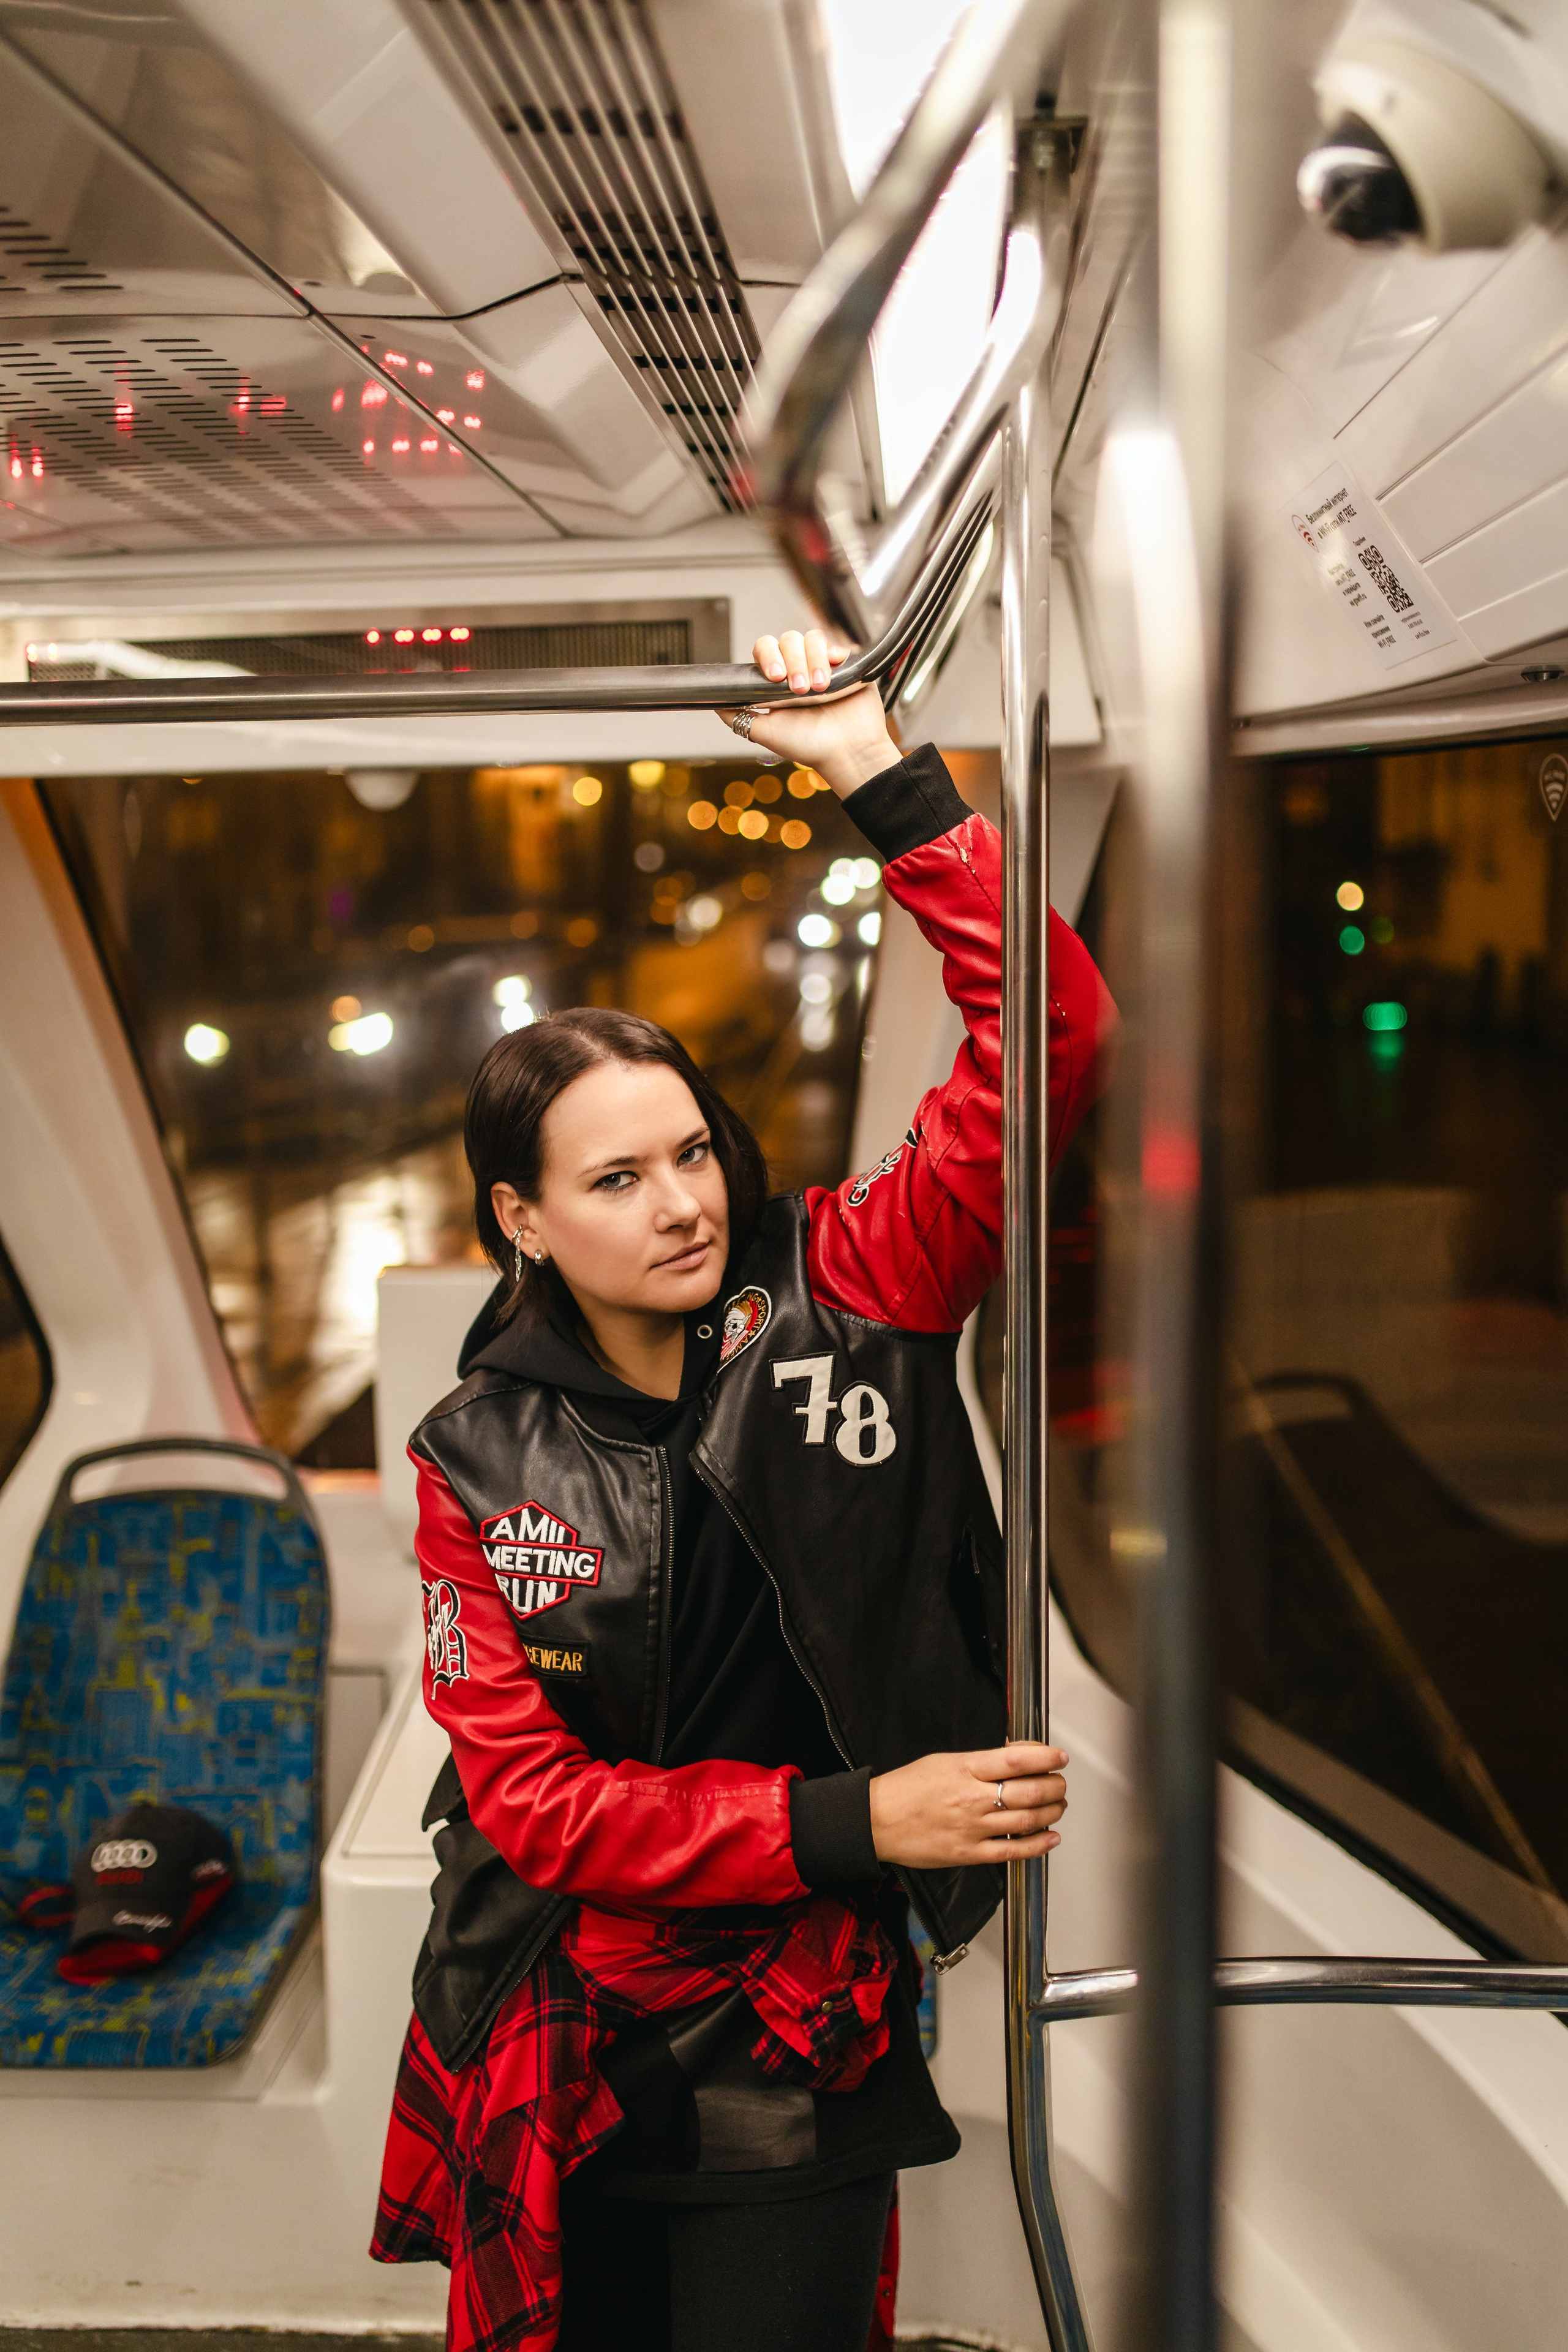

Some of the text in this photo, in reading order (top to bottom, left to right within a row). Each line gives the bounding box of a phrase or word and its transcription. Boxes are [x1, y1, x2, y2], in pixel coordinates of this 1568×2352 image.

[1336, 504, 1357, 524] MT_FREE
[770, 1352, 897, 1466] 78
[481, 1544, 596, 1578] MEETING
[494, 1573, 557, 1613] RUN
